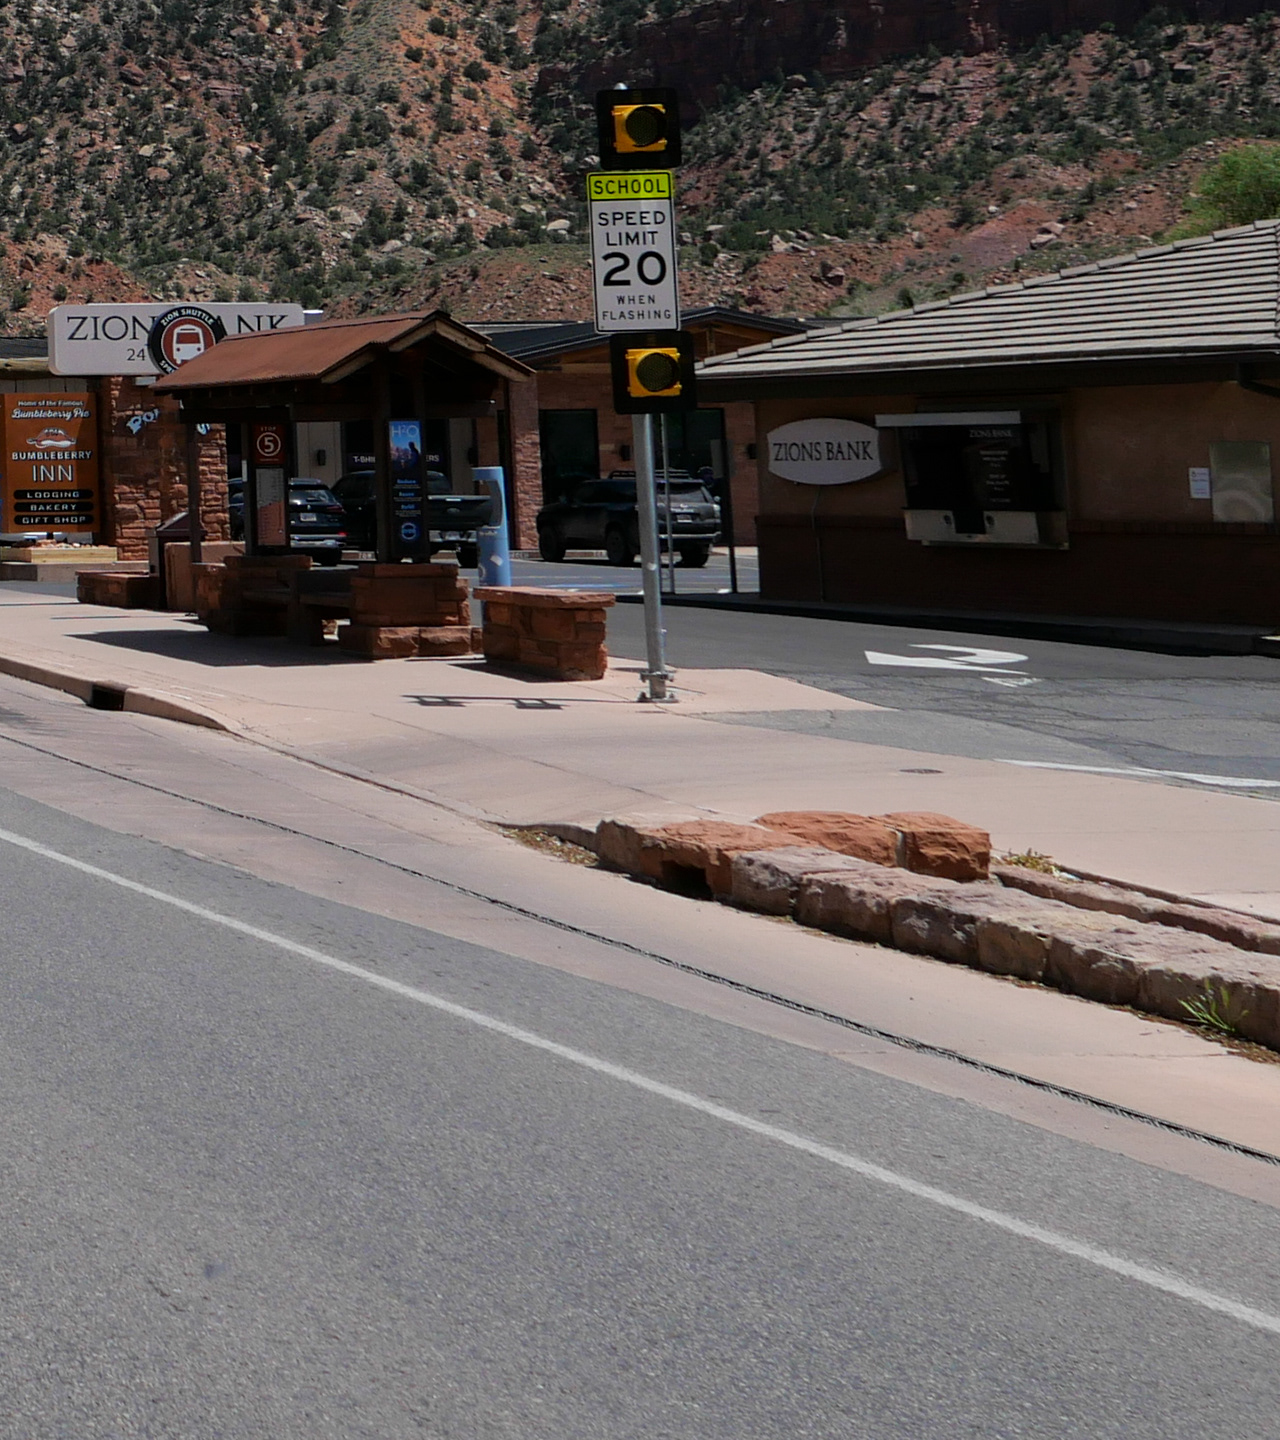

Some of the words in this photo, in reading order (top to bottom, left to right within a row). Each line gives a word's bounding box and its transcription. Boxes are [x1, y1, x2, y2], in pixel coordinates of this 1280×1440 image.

[593, 178, 666, 195] SCHOOL
[598, 211, 666, 226] SPEED
[606, 231, 659, 246] LIMIT
[601, 251, 666, 286] 20
[616, 294, 656, 305] WHEN
[161, 310, 180, 327] ZION
[181, 308, 214, 325] SHUTTLE
[602, 309, 671, 321] FLASHING
[66, 315, 157, 341] ZION
[127, 348, 147, 362] 24
[11, 408, 73, 421] Bumbleberry
[73, 407, 91, 419] Pie
[264, 436, 275, 453] 5
[772, 441, 822, 462] ZIONS
[824, 440, 874, 461] BANK
[11, 451, 92, 461] BUMBLEBERRY
[352, 455, 376, 463] T-SHI
[32, 464, 74, 482] INN
[26, 491, 81, 499] LODGING
[30, 503, 77, 511] BAKERY
[21, 516, 48, 525] GIFT
[54, 515, 87, 524] SHOP
